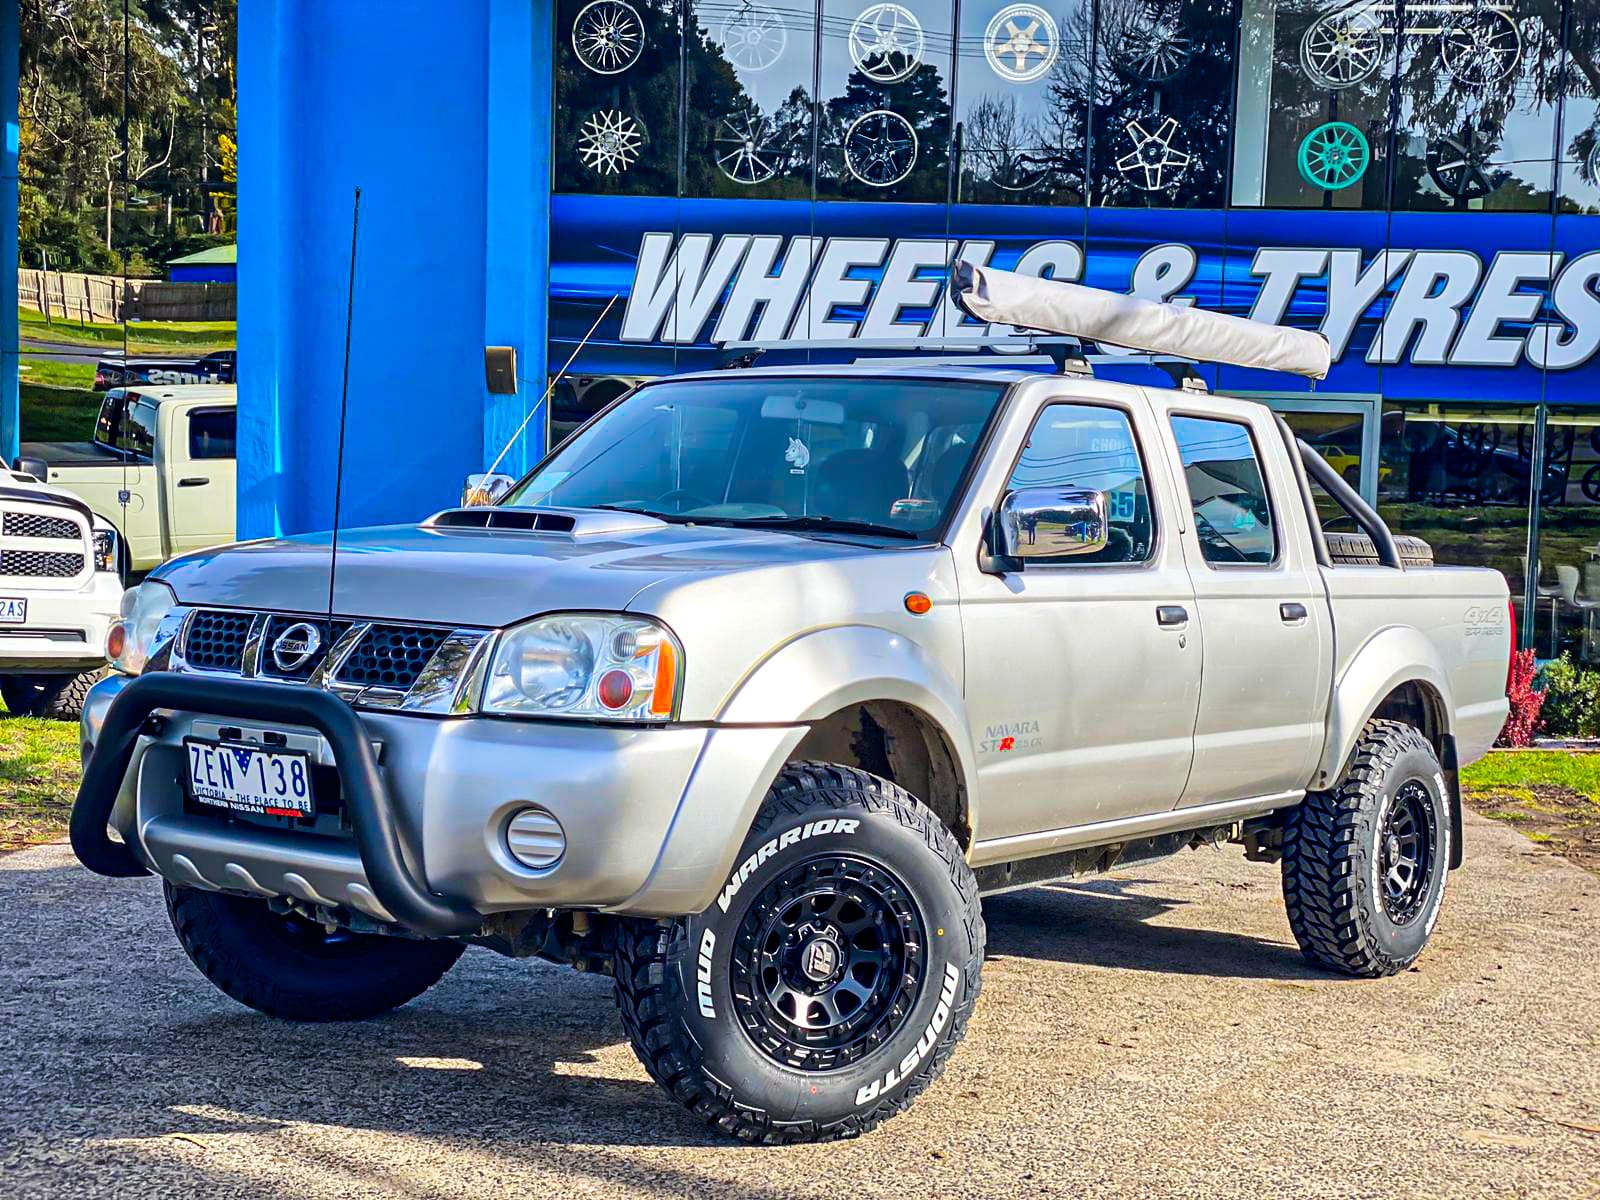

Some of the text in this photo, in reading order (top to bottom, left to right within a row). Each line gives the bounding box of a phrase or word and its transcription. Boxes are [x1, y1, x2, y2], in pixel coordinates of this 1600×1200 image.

[1246, 247, 1600, 370] TYRES
[985, 720, 1039, 738] NAVARA
[191, 746, 306, 798] ZEN 138
[194, 785, 226, 799] VICTORIA
[236, 793, 251, 804] THE
[254, 795, 278, 808] PLACE
[281, 799, 293, 809] TO
[298, 800, 309, 811] BE
[230, 801, 265, 814] NISSAN
[697, 818, 860, 1019] MUD WARRIOR
[854, 961, 960, 1106] MONSTA
